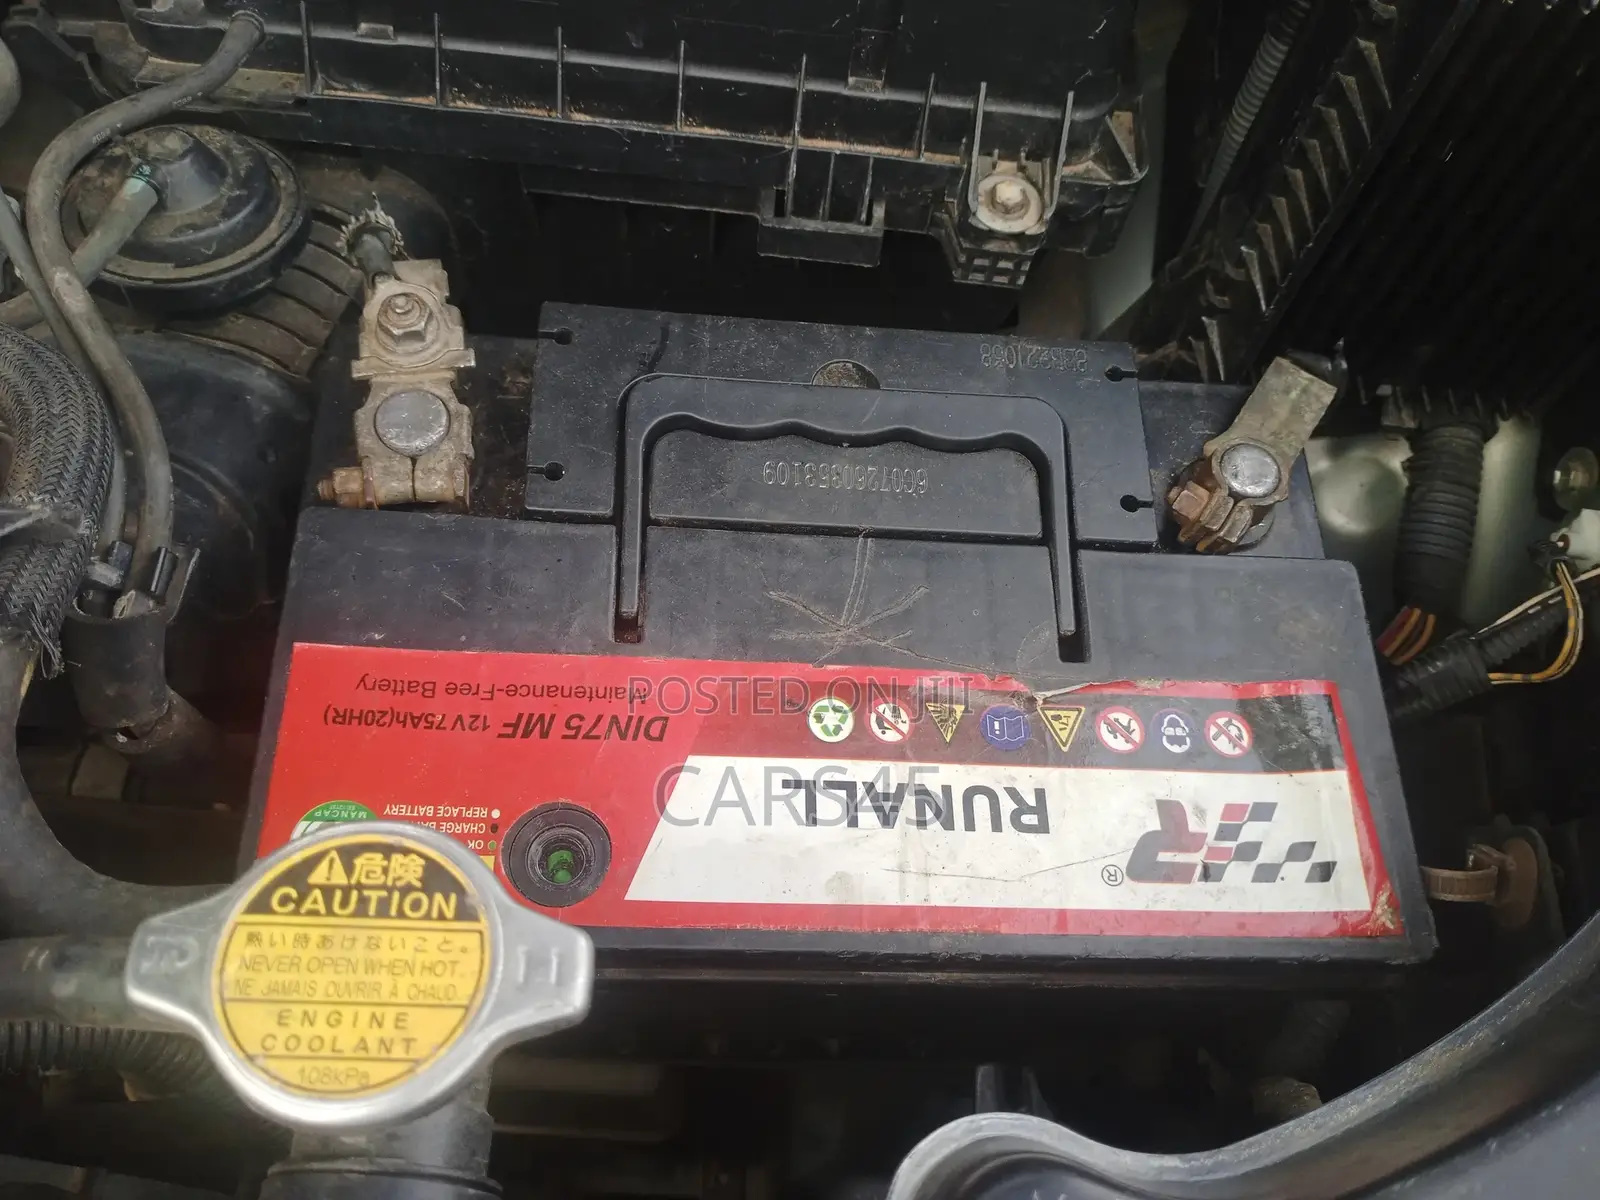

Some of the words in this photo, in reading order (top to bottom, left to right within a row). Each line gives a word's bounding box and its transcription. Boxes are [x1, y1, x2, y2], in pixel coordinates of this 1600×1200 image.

[355, 673, 437, 699] Battery
[445, 680, 647, 706] Maintenance-Free
[450, 712, 491, 733] 12V
[496, 711, 557, 740] MF
[560, 712, 670, 743] DIN75
[314, 809, 368, 819] MANCAP
[383, 803, 435, 817] BATTERY
[436, 805, 488, 818] REPLACE
[781, 778, 1050, 835] RUNALL
[438, 821, 486, 834] CHARGE
[467, 839, 484, 850] OK
[350, 852, 426, 889] 危険
[270, 885, 458, 920] CAUTION
[241, 953, 302, 973] NEVER
[306, 955, 359, 976] OPEN
[364, 957, 416, 978] WHEN
[234, 978, 256, 997] NE
[260, 979, 318, 998] JAMAIS
[276, 1008, 410, 1031] ENGINE
[260, 1032, 418, 1056] COOLANT
